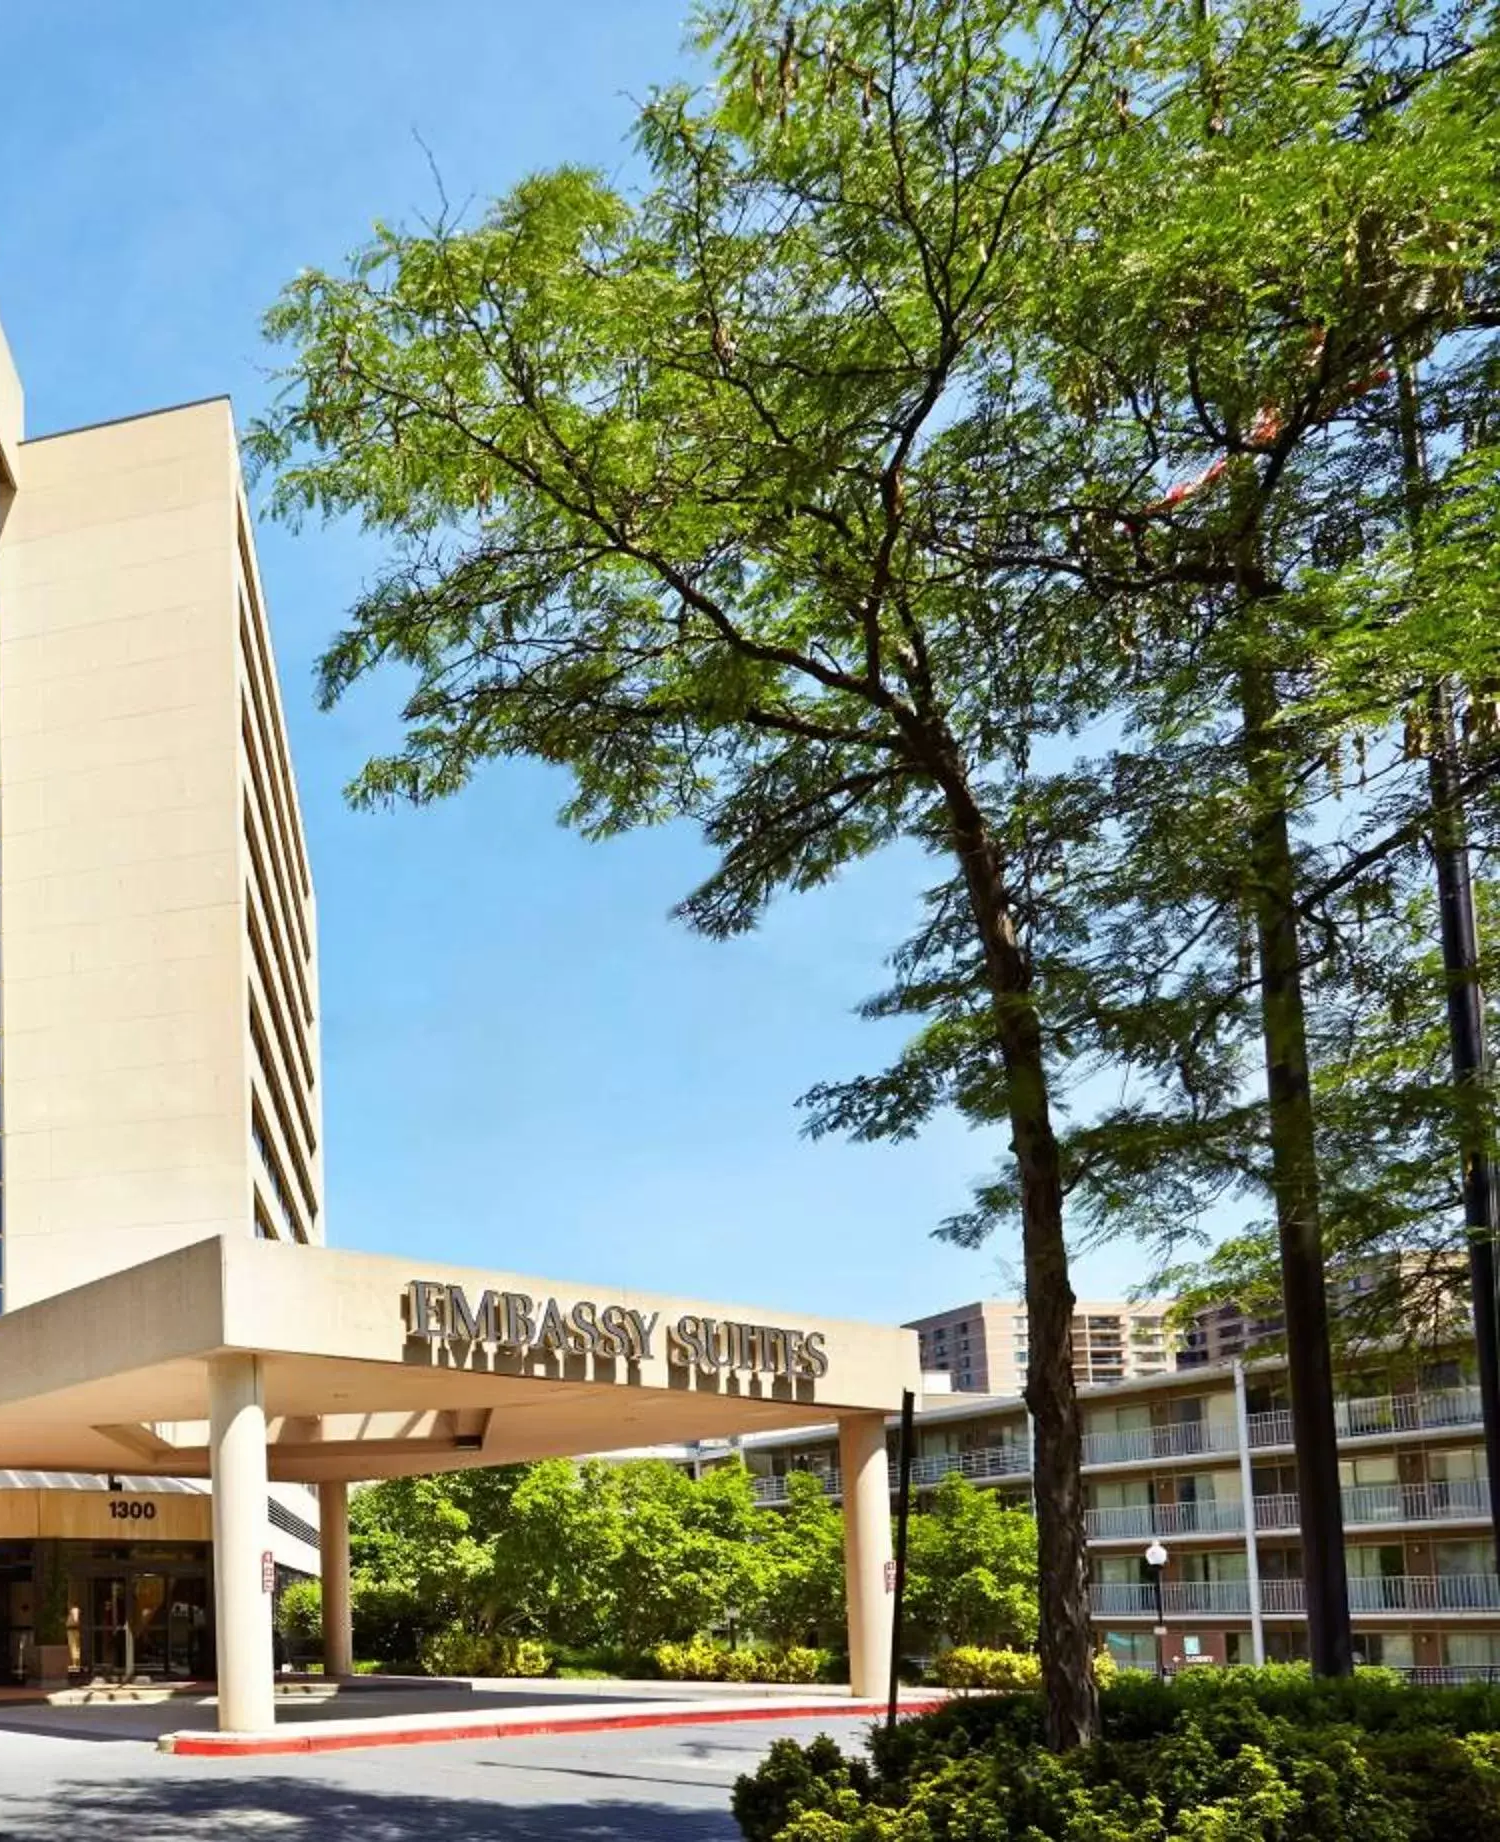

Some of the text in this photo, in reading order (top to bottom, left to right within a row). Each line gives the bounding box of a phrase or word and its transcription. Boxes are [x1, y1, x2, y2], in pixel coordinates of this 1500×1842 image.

[405, 1279, 829, 1380] EMBASSY SUITES
[109, 1500, 156, 1520] 1300
